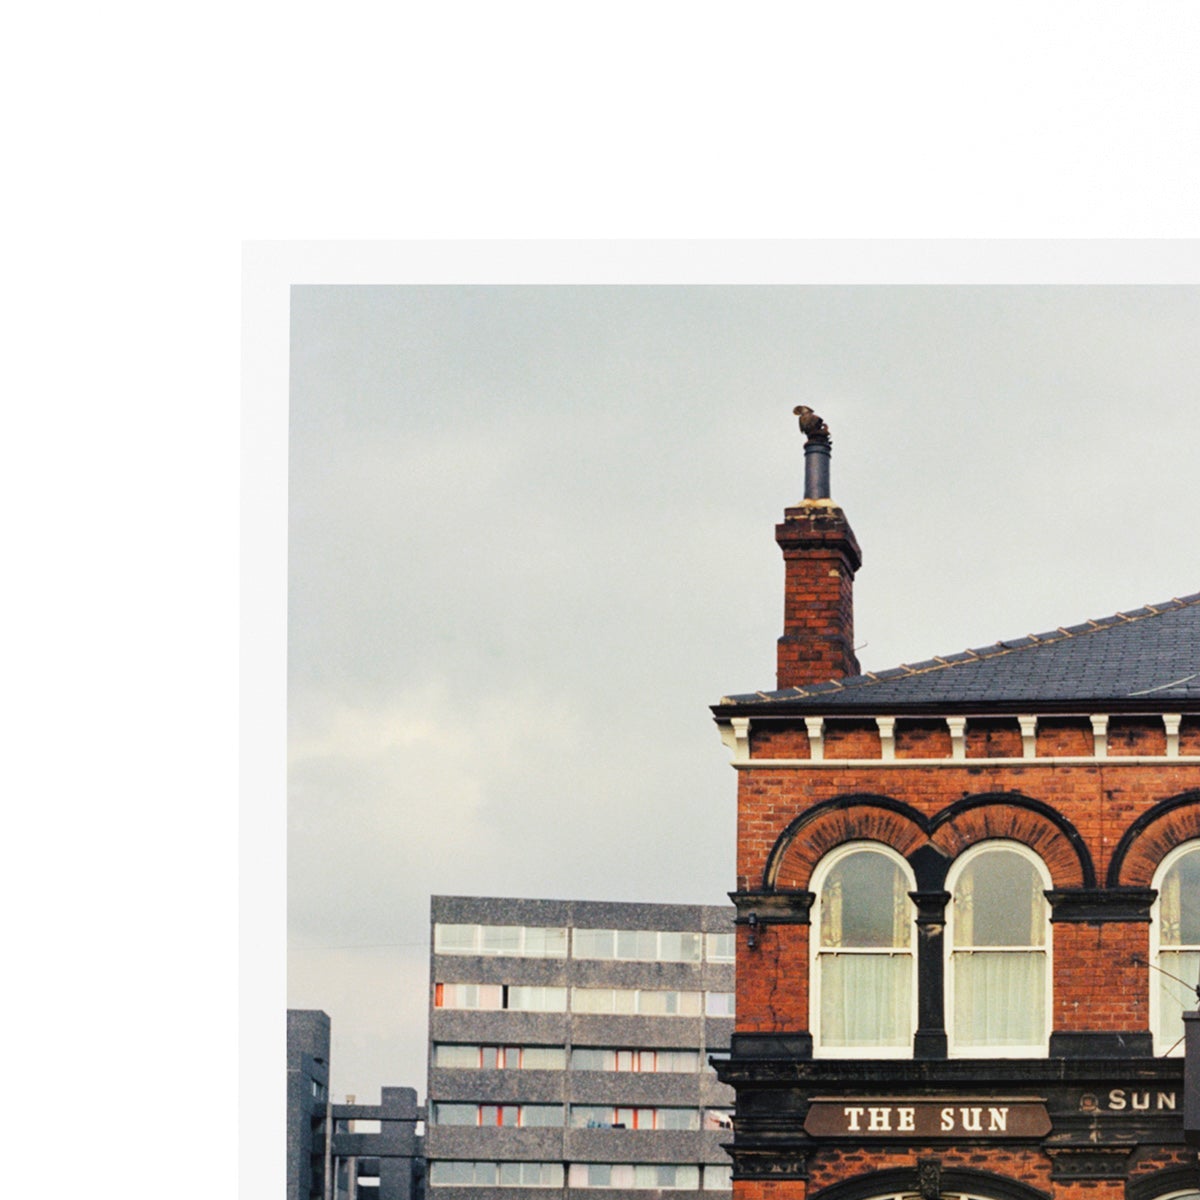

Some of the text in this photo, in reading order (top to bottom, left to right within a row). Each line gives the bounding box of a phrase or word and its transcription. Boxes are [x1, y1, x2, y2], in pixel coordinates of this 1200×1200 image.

[1108, 1089, 1176, 1110] SUN
[844, 1107, 1009, 1131] THE SUN
